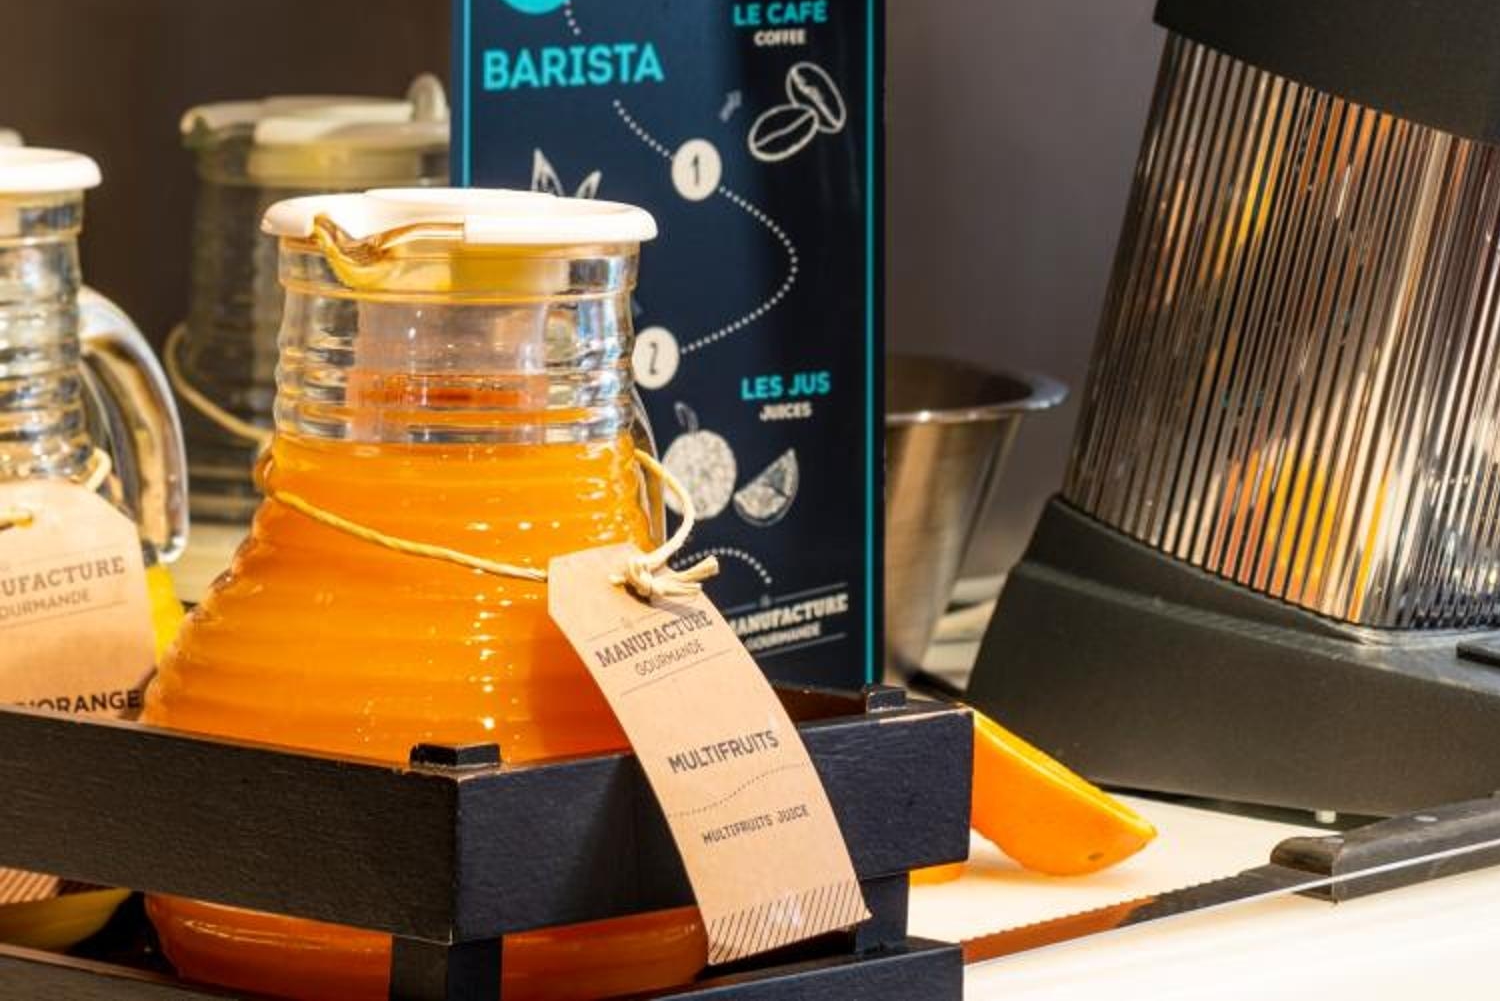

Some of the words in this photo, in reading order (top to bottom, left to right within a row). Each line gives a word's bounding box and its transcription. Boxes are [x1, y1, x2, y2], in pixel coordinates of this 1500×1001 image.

[734, 3, 761, 26] LE
[754, 29, 806, 47] COFFEE
[483, 43, 664, 91] BARISTA
[741, 375, 783, 401] LES
[788, 371, 831, 396] JUS
[759, 402, 812, 421] JUICES
[0, 555, 126, 597] UFACTURE
[0, 588, 90, 618] OURMANDE
[595, 610, 713, 667] MANUFACTURE
[635, 638, 705, 676] GOURMANDE
[667, 730, 779, 774] MULTIFRUITS
[702, 814, 774, 845] MULTIFRUITS
[776, 804, 810, 823] JUICE
